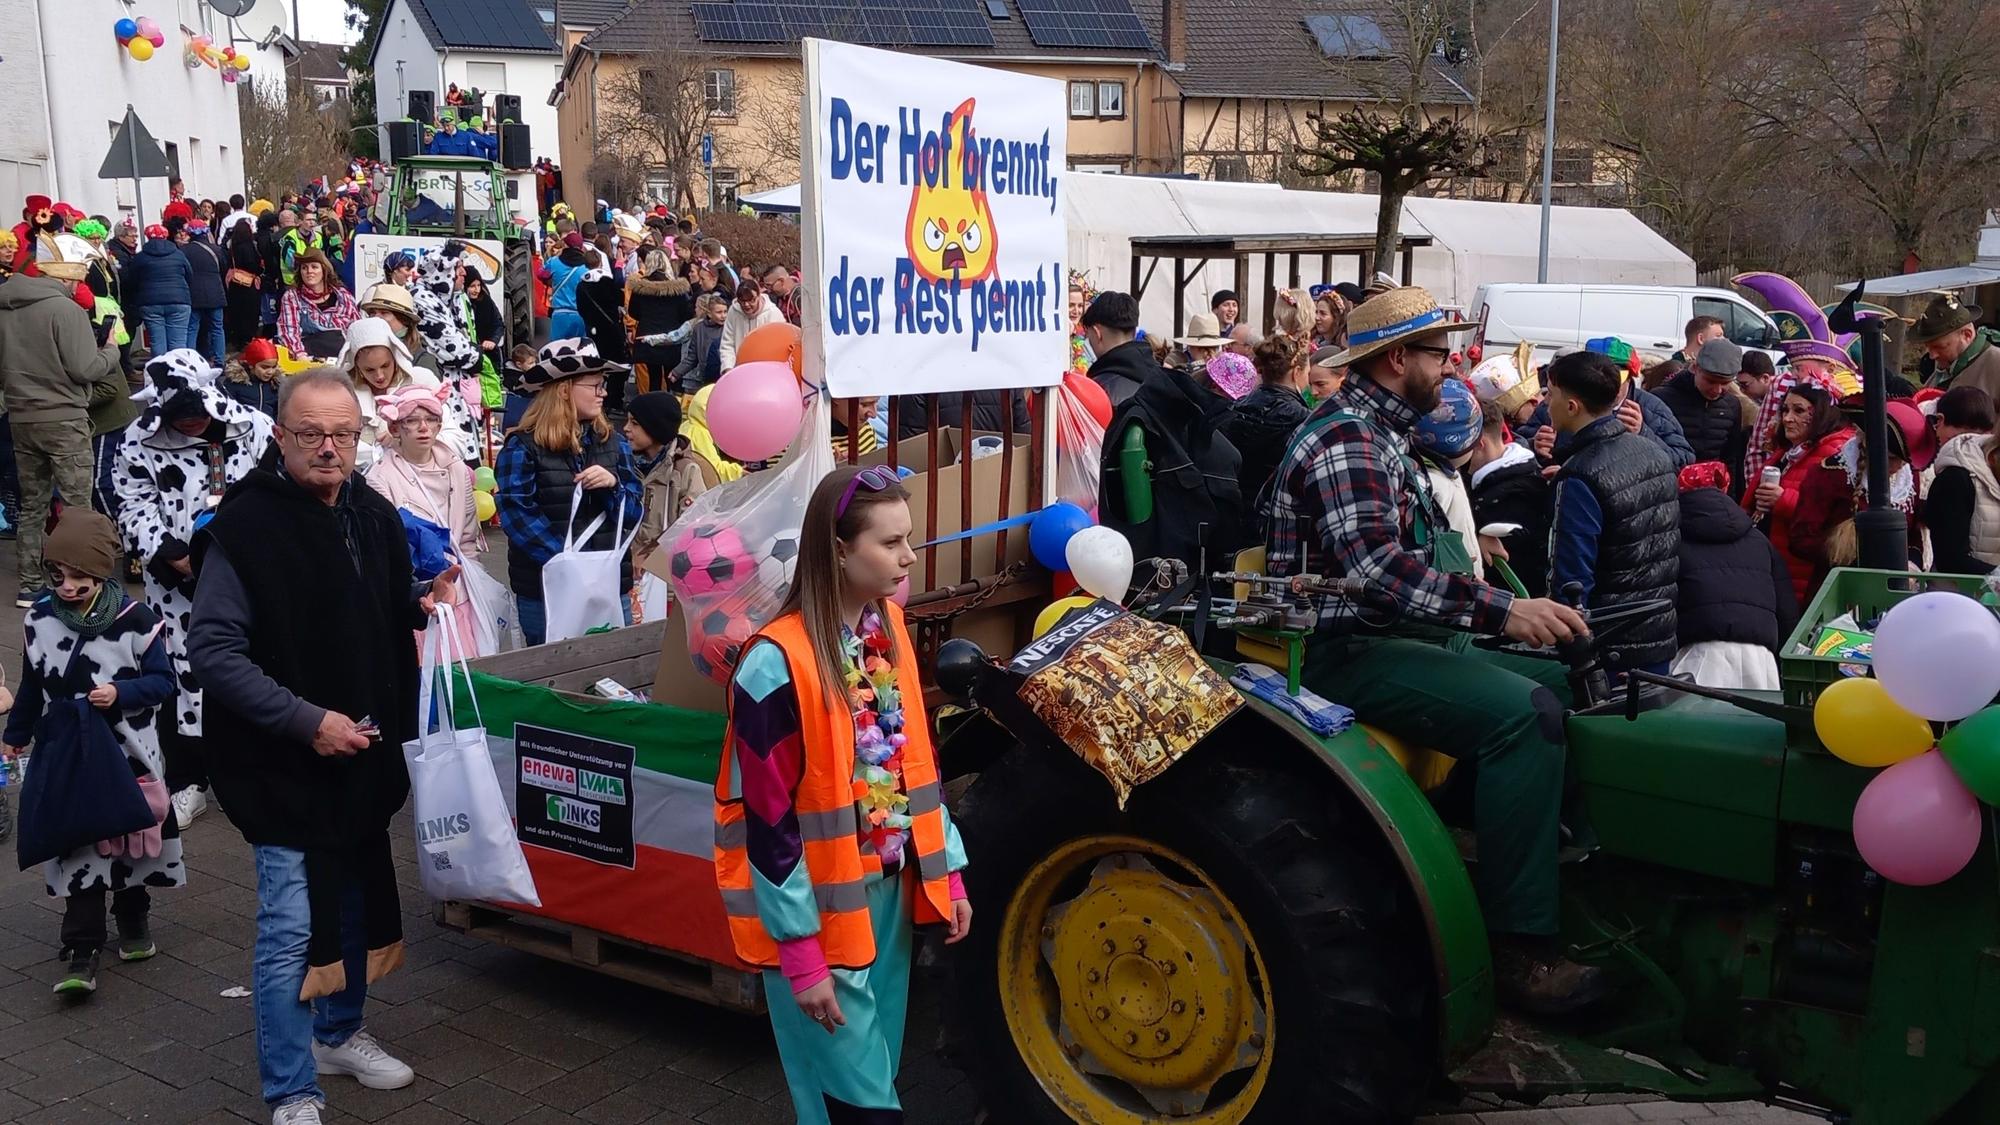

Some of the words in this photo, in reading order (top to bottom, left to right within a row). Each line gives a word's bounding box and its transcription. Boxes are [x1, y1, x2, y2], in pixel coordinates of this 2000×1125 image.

[704, 139, 710, 161] P
[830, 97, 890, 184] Der
[899, 106, 953, 189] Hof
[962, 115, 1058, 216] brennt,
[829, 255, 884, 336] der
[894, 257, 963, 335] Rest
[971, 262, 1047, 352] pennt
[531, 742, 569, 758] freundlicher
[569, 751, 613, 769] Unterstützung
[523, 759, 575, 784] enewa
[554, 800, 600, 828] TINKS
[525, 825, 537, 833] und
[537, 827, 550, 837] den
[551, 830, 577, 842] Privaten
